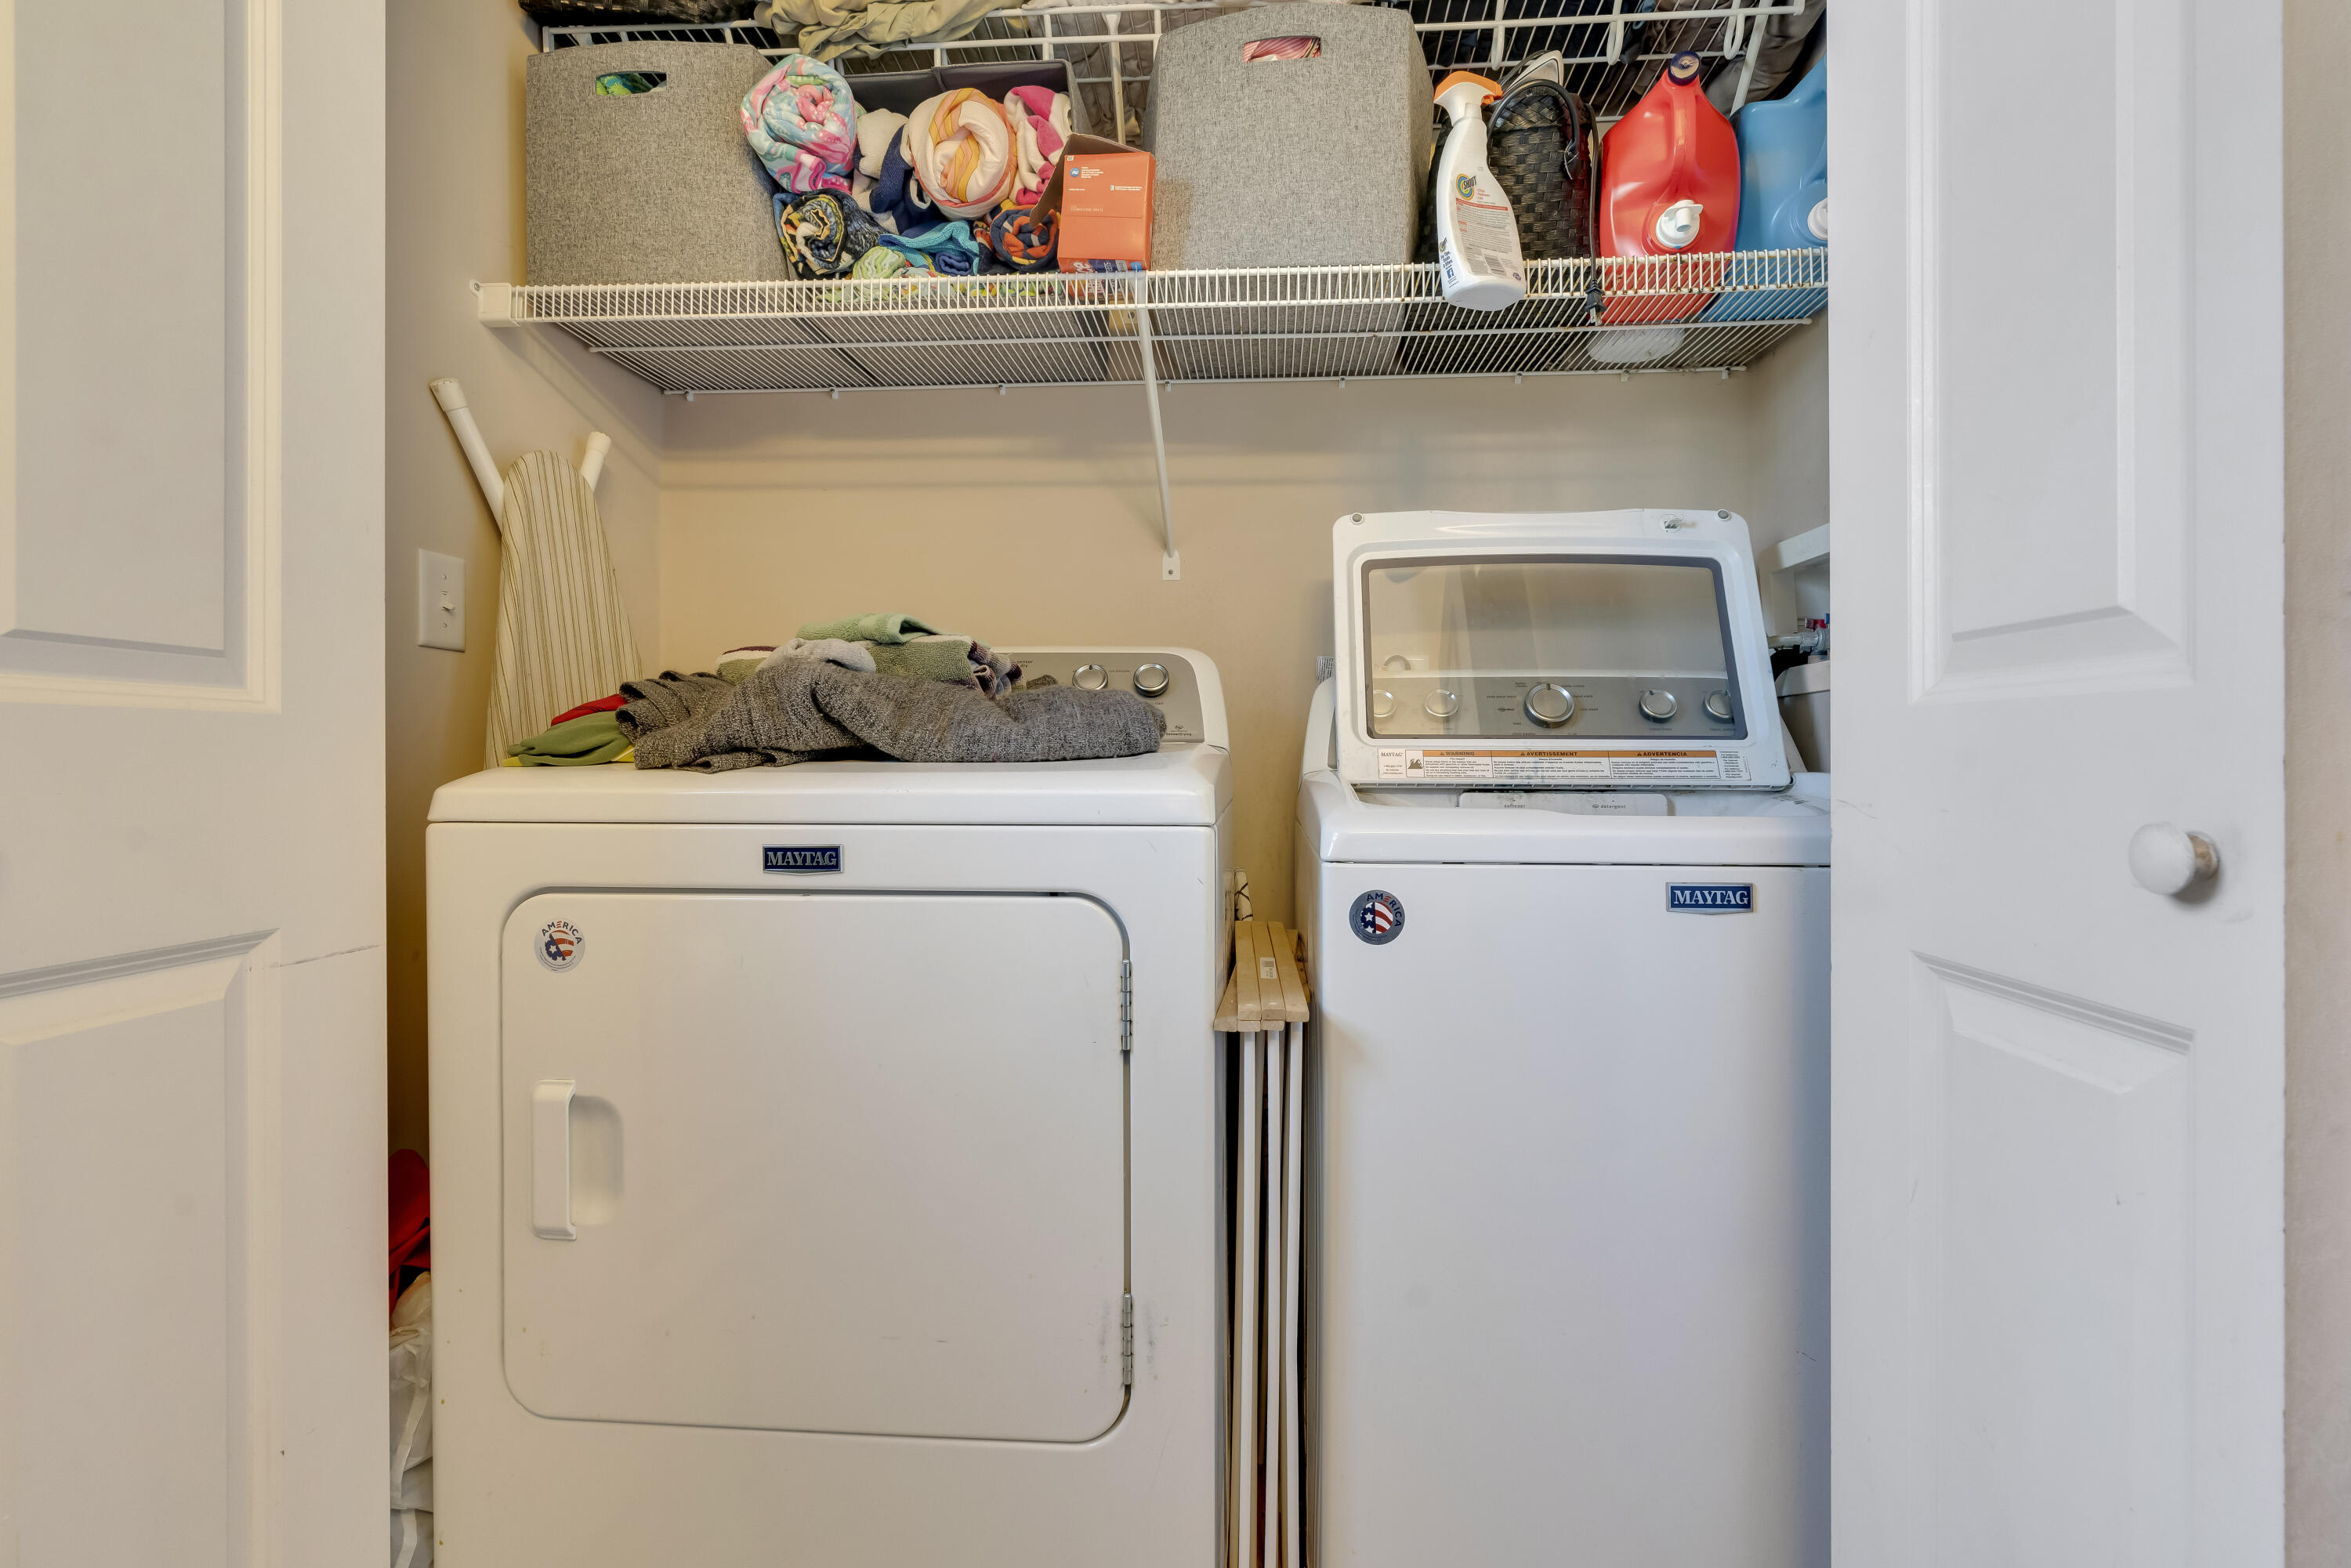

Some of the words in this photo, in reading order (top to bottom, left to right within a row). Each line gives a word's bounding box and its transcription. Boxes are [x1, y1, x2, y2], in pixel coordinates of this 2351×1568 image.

[1463, 175, 1476, 190] SHOUT
[766, 852, 837, 865] MAYTAG
[1673, 890, 1748, 904] MAYTAG
[1367, 893, 1402, 926] AMERICA
[542, 921, 582, 944] AMERICA
